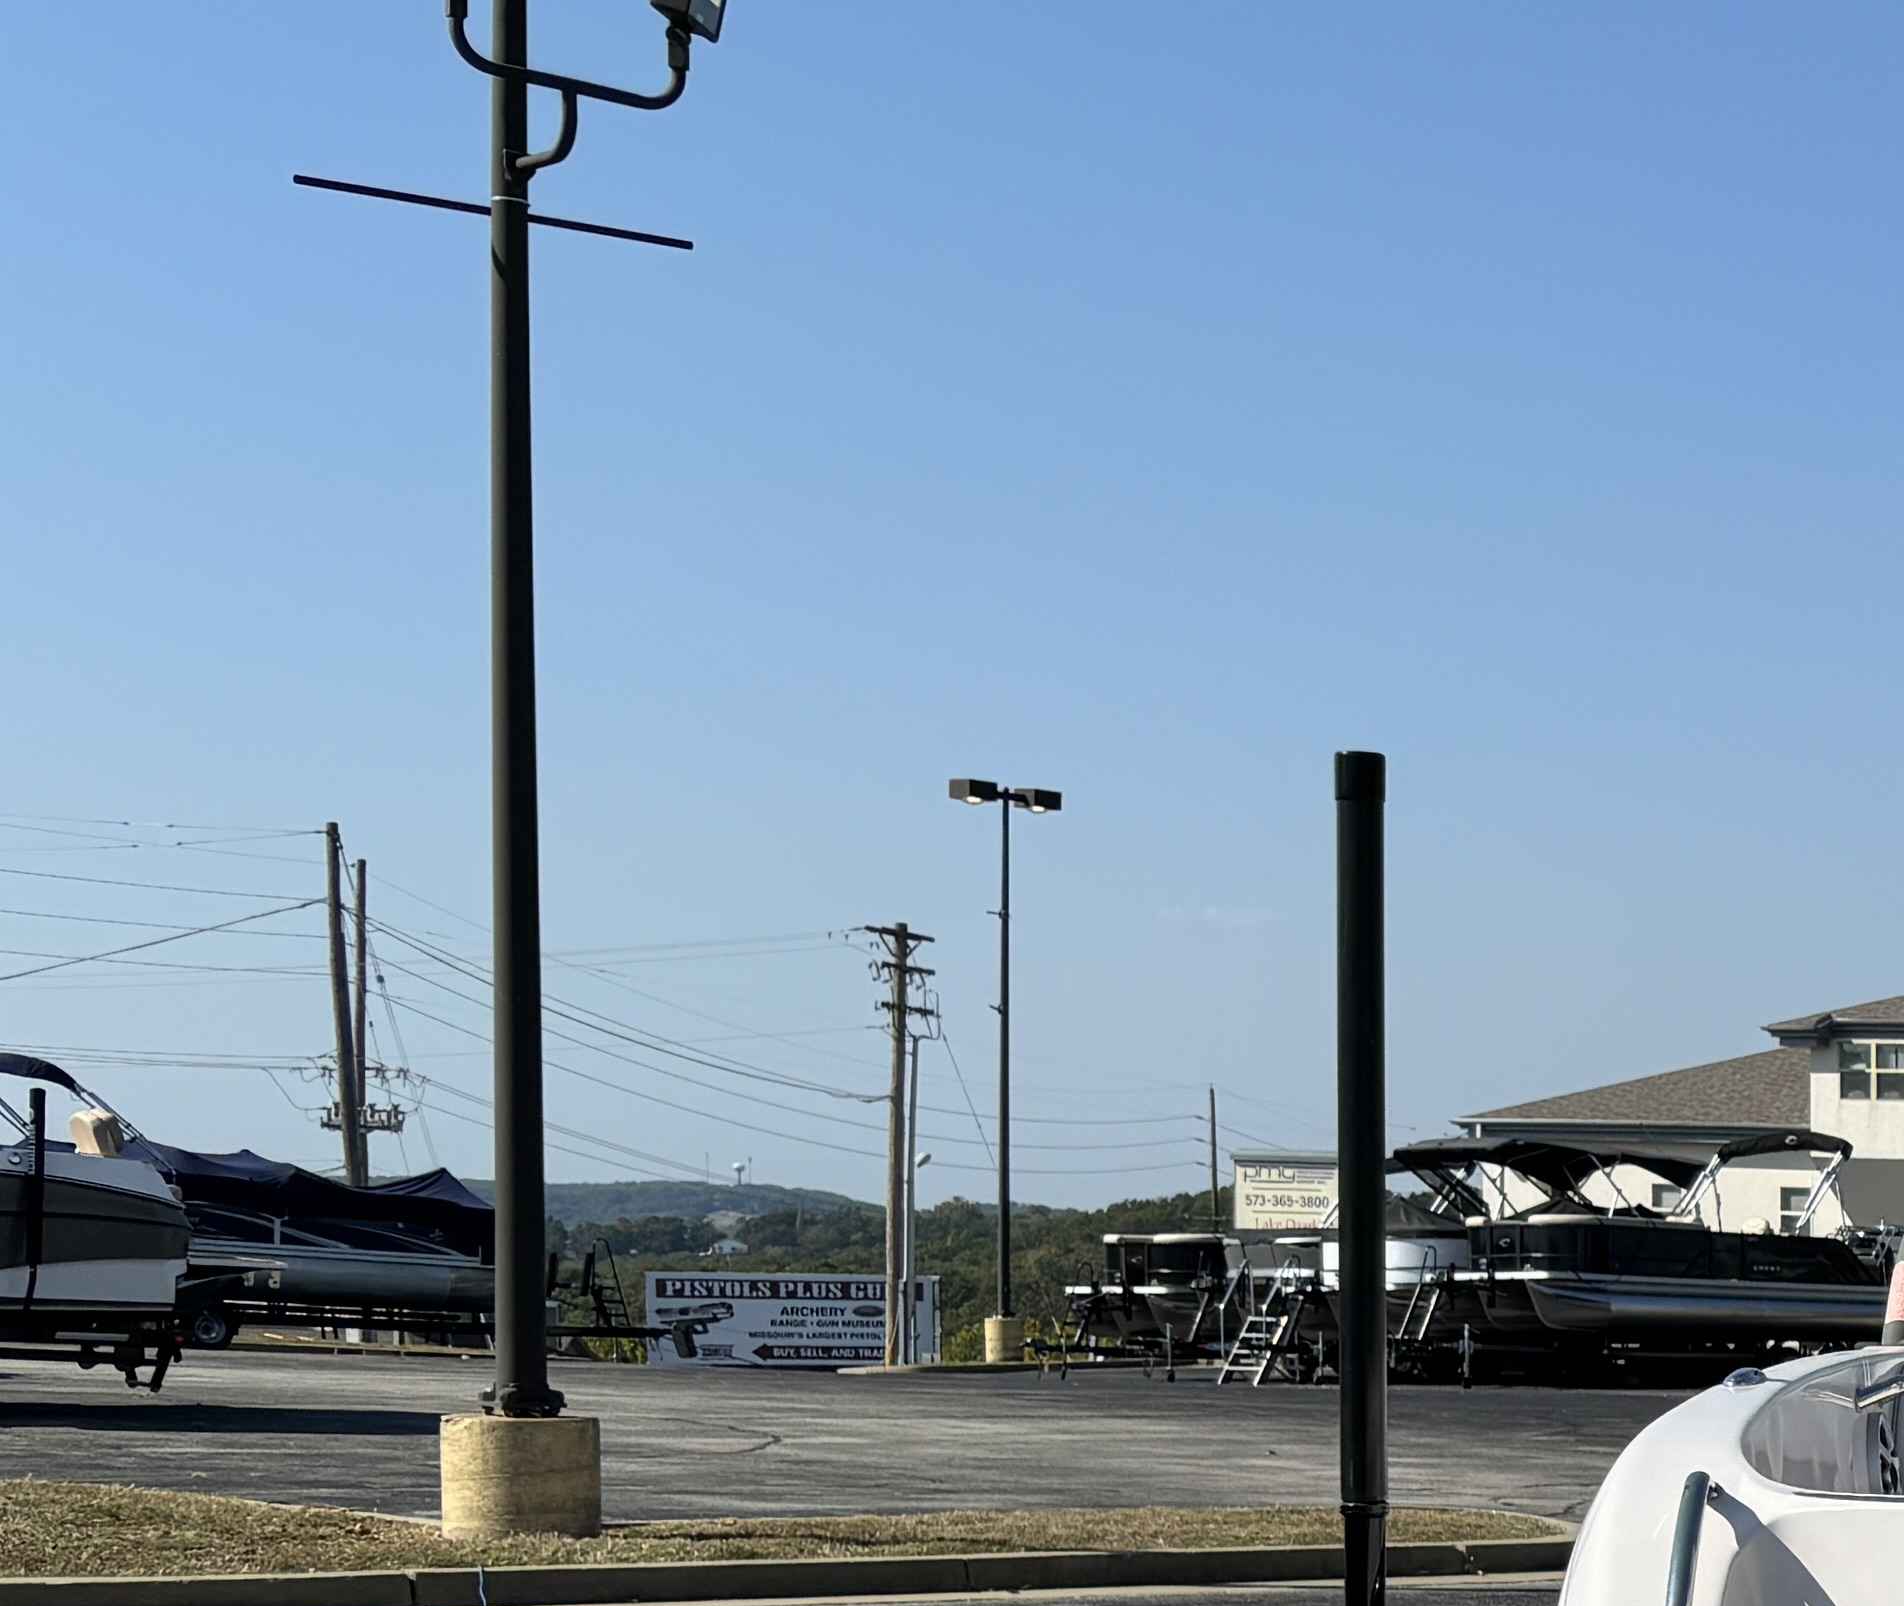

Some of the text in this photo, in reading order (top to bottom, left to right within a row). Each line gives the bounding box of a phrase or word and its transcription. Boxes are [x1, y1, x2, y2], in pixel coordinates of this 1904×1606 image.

[665, 1280, 882, 1299] PISTOLS PLUS GU
[780, 1306, 847, 1317] ARCHERY
[831, 1347, 855, 1358] AND
